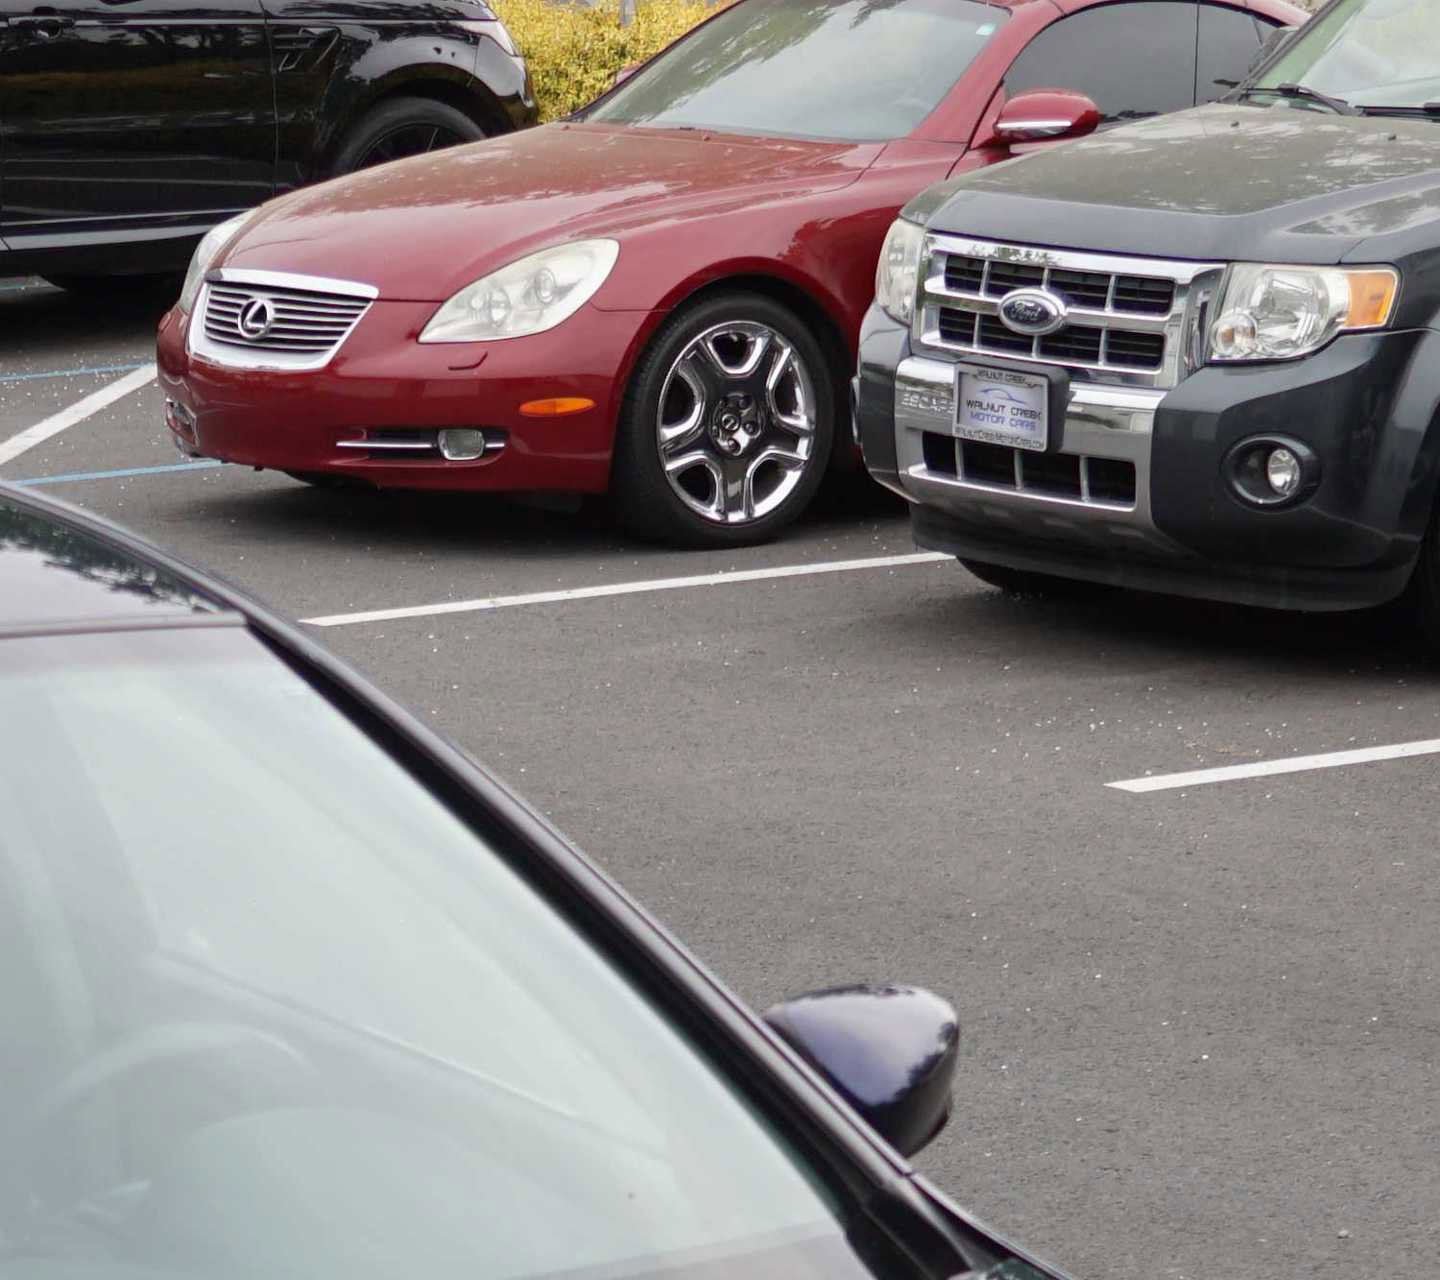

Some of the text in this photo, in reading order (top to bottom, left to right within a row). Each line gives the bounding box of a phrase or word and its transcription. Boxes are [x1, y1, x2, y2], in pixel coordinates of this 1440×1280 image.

[967, 399, 1042, 420] WALNUT CREEK
[970, 411, 1037, 432] MOTOR CARS
